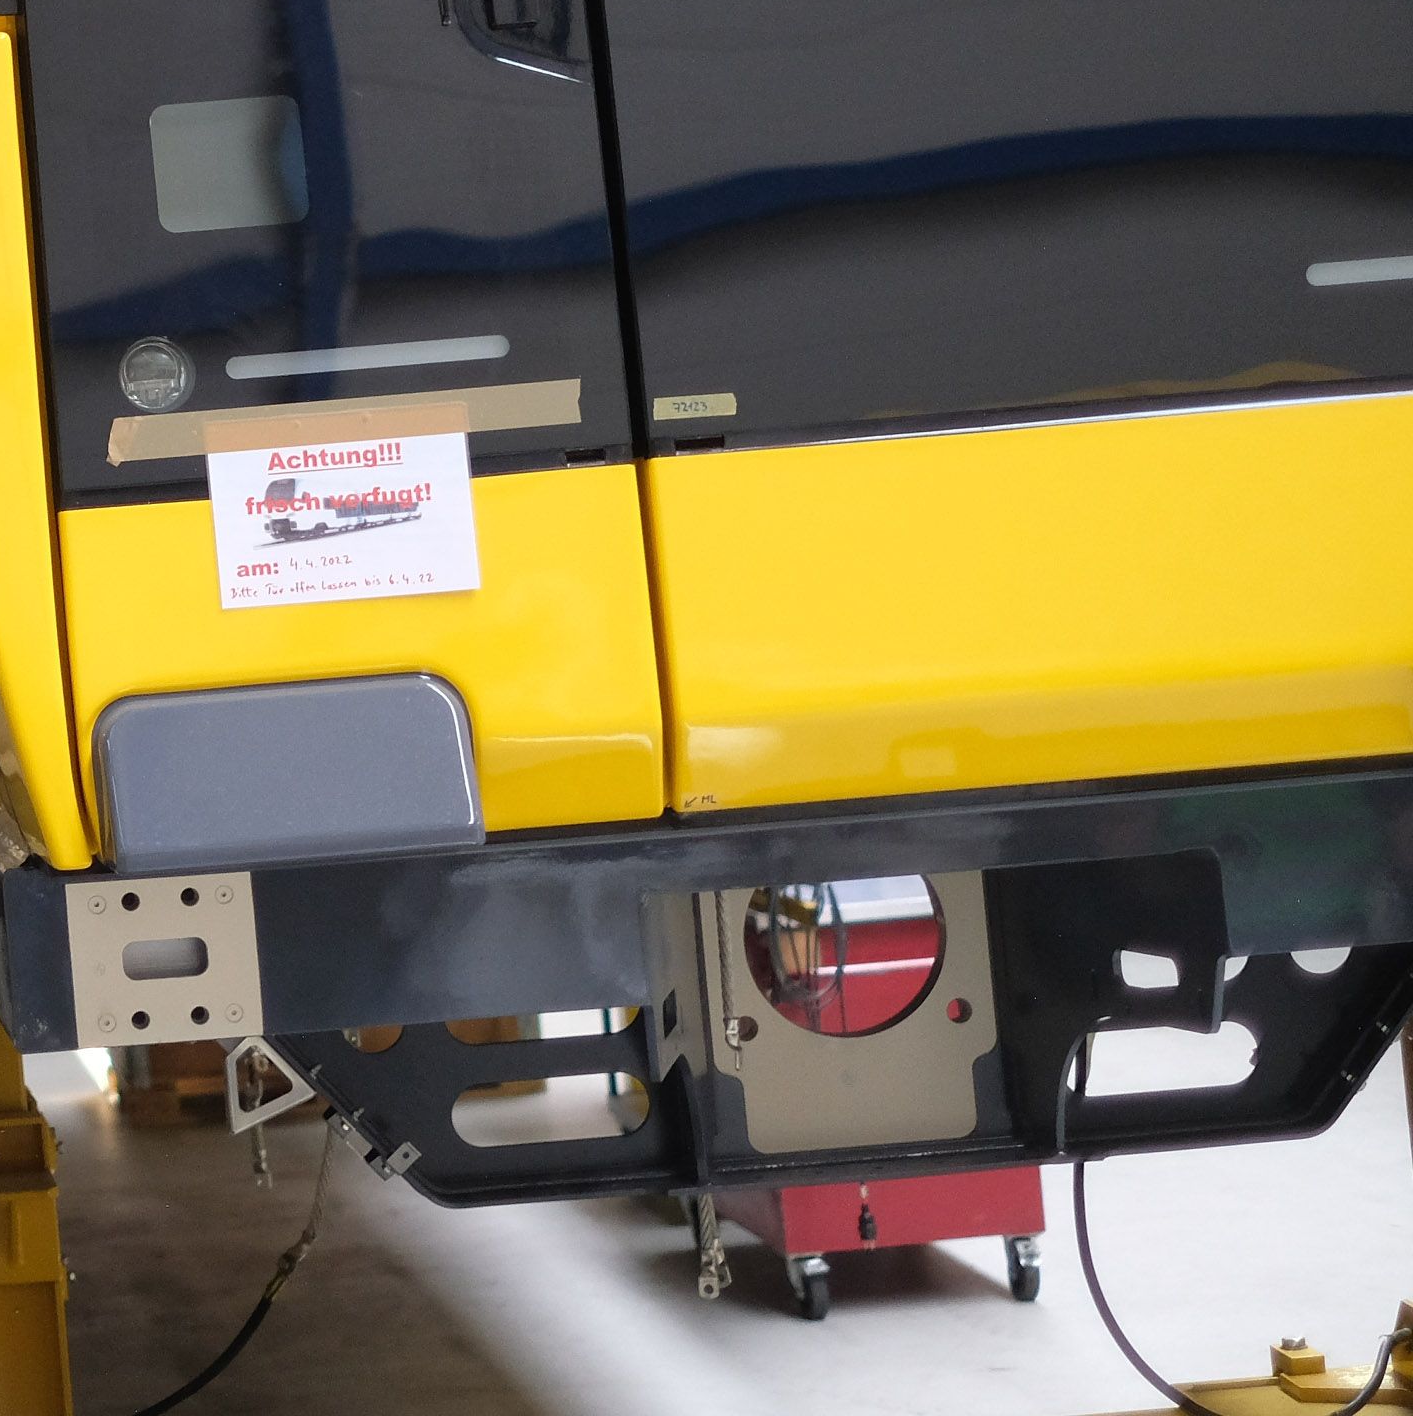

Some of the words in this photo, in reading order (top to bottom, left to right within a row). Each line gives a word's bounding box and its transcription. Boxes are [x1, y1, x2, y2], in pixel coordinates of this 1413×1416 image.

[267, 442, 403, 471] Achtung!!!
[245, 490, 321, 515] frisch
[328, 482, 432, 510] verfugt!
[236, 561, 280, 578] am:
[364, 574, 382, 587] bis
